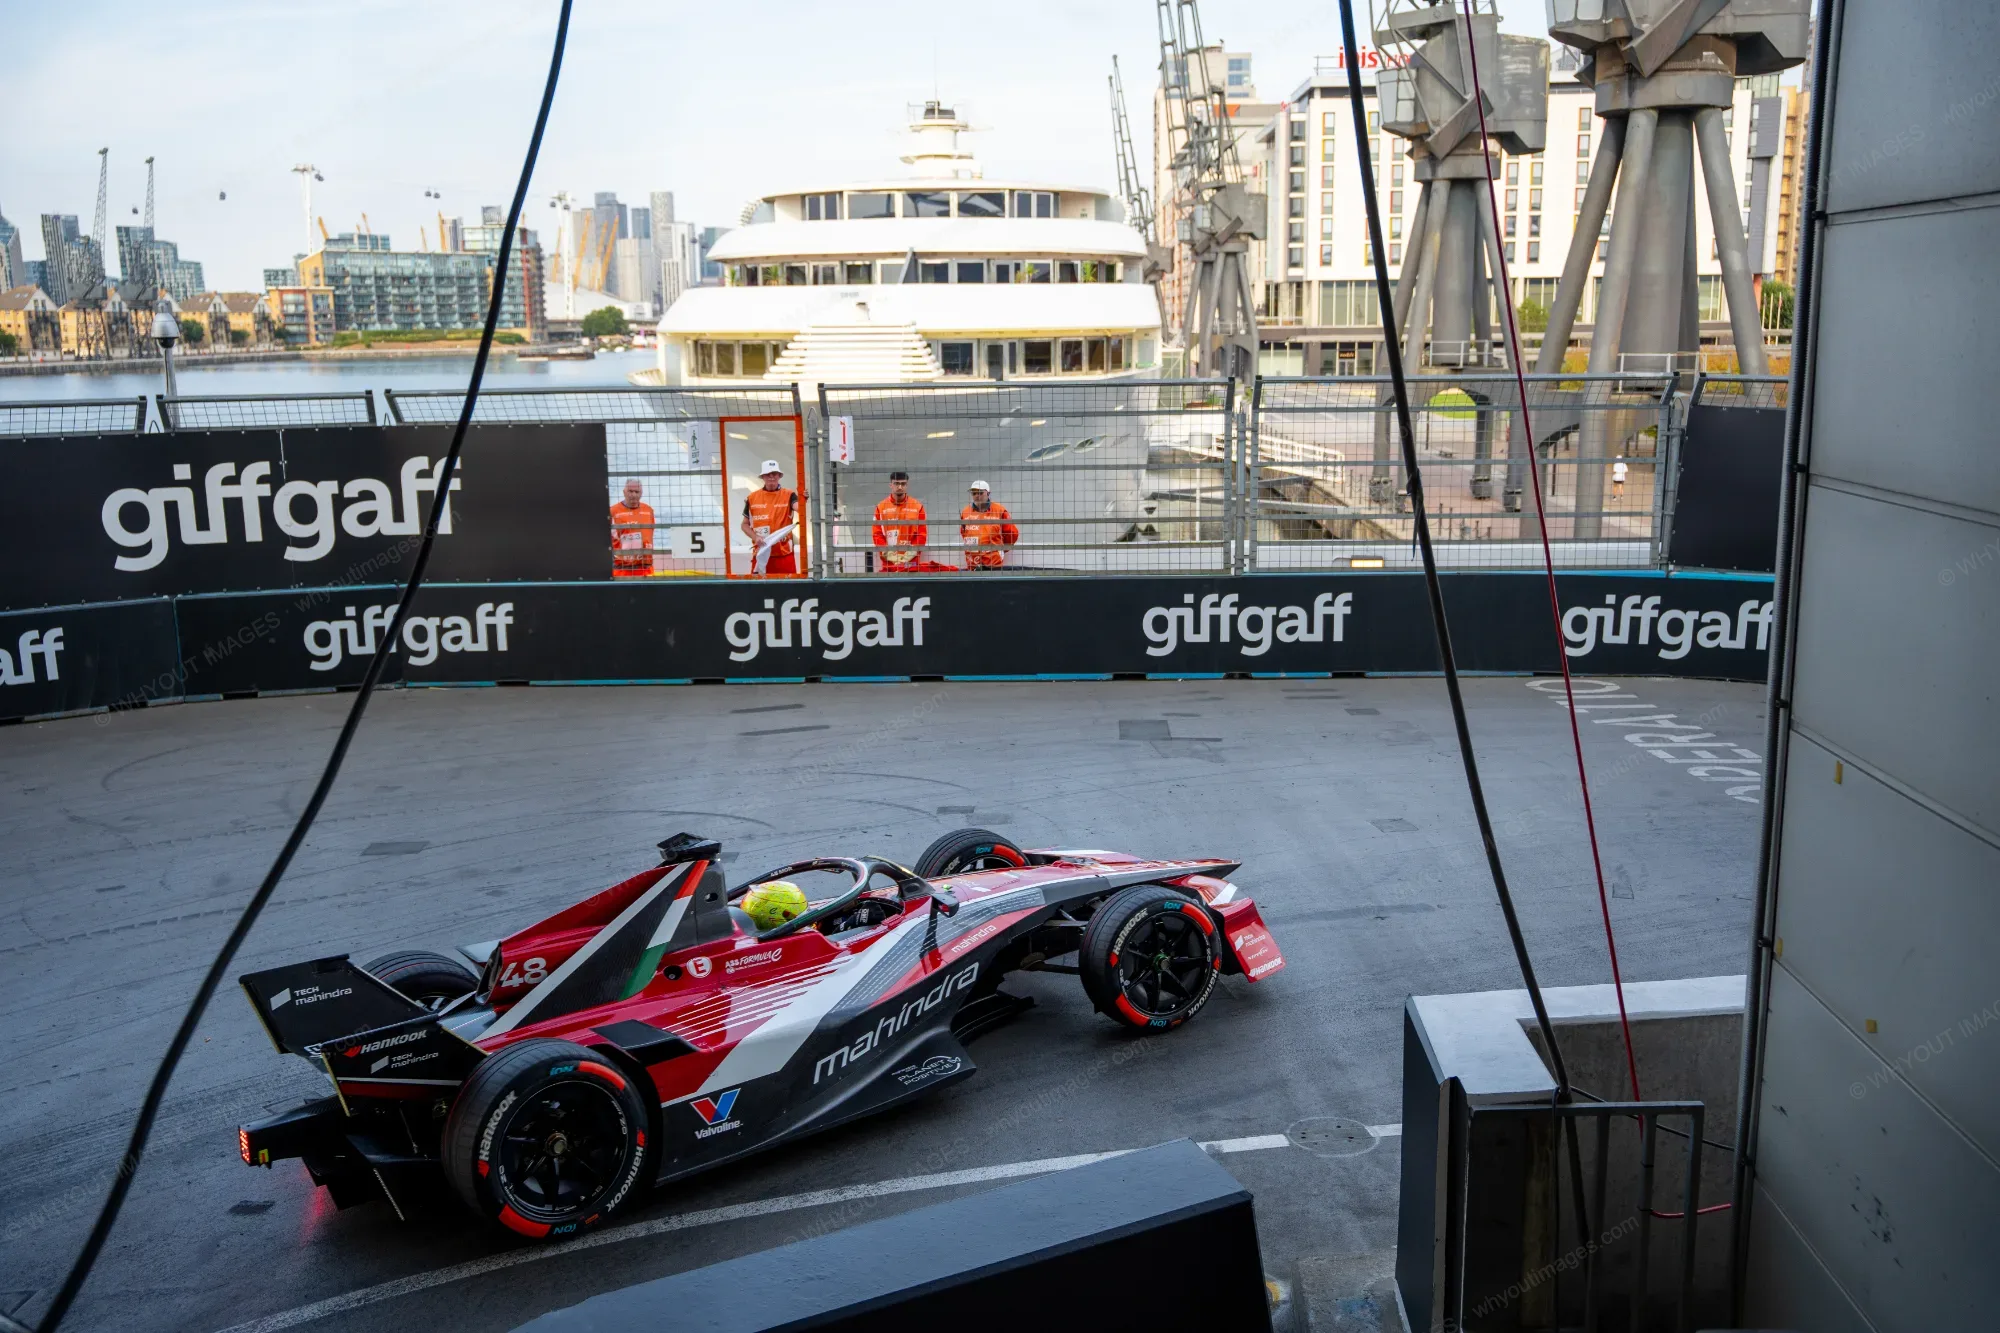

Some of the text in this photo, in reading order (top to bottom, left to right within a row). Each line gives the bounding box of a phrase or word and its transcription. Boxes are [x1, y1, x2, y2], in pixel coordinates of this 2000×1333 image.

[1338, 46, 1379, 68] iis
[101, 456, 462, 572] giffgaff
[690, 531, 705, 553] 5
[304, 602, 514, 671] giffgaff
[724, 597, 930, 661] giffgaff
[1142, 592, 1353, 656] giffgaff
[1562, 594, 1774, 660] giffgaff
[951, 925, 996, 954] mahindra
[501, 957, 548, 988] 48
[294, 986, 320, 997] TECH
[295, 987, 353, 1006] mahindra
[813, 962, 979, 1085] mahindra
[391, 1052, 439, 1069] mahindra
[897, 1059, 946, 1082] PLANET
[903, 1061, 953, 1086] POSITIVE
[694, 1120, 741, 1140] Valvoline
